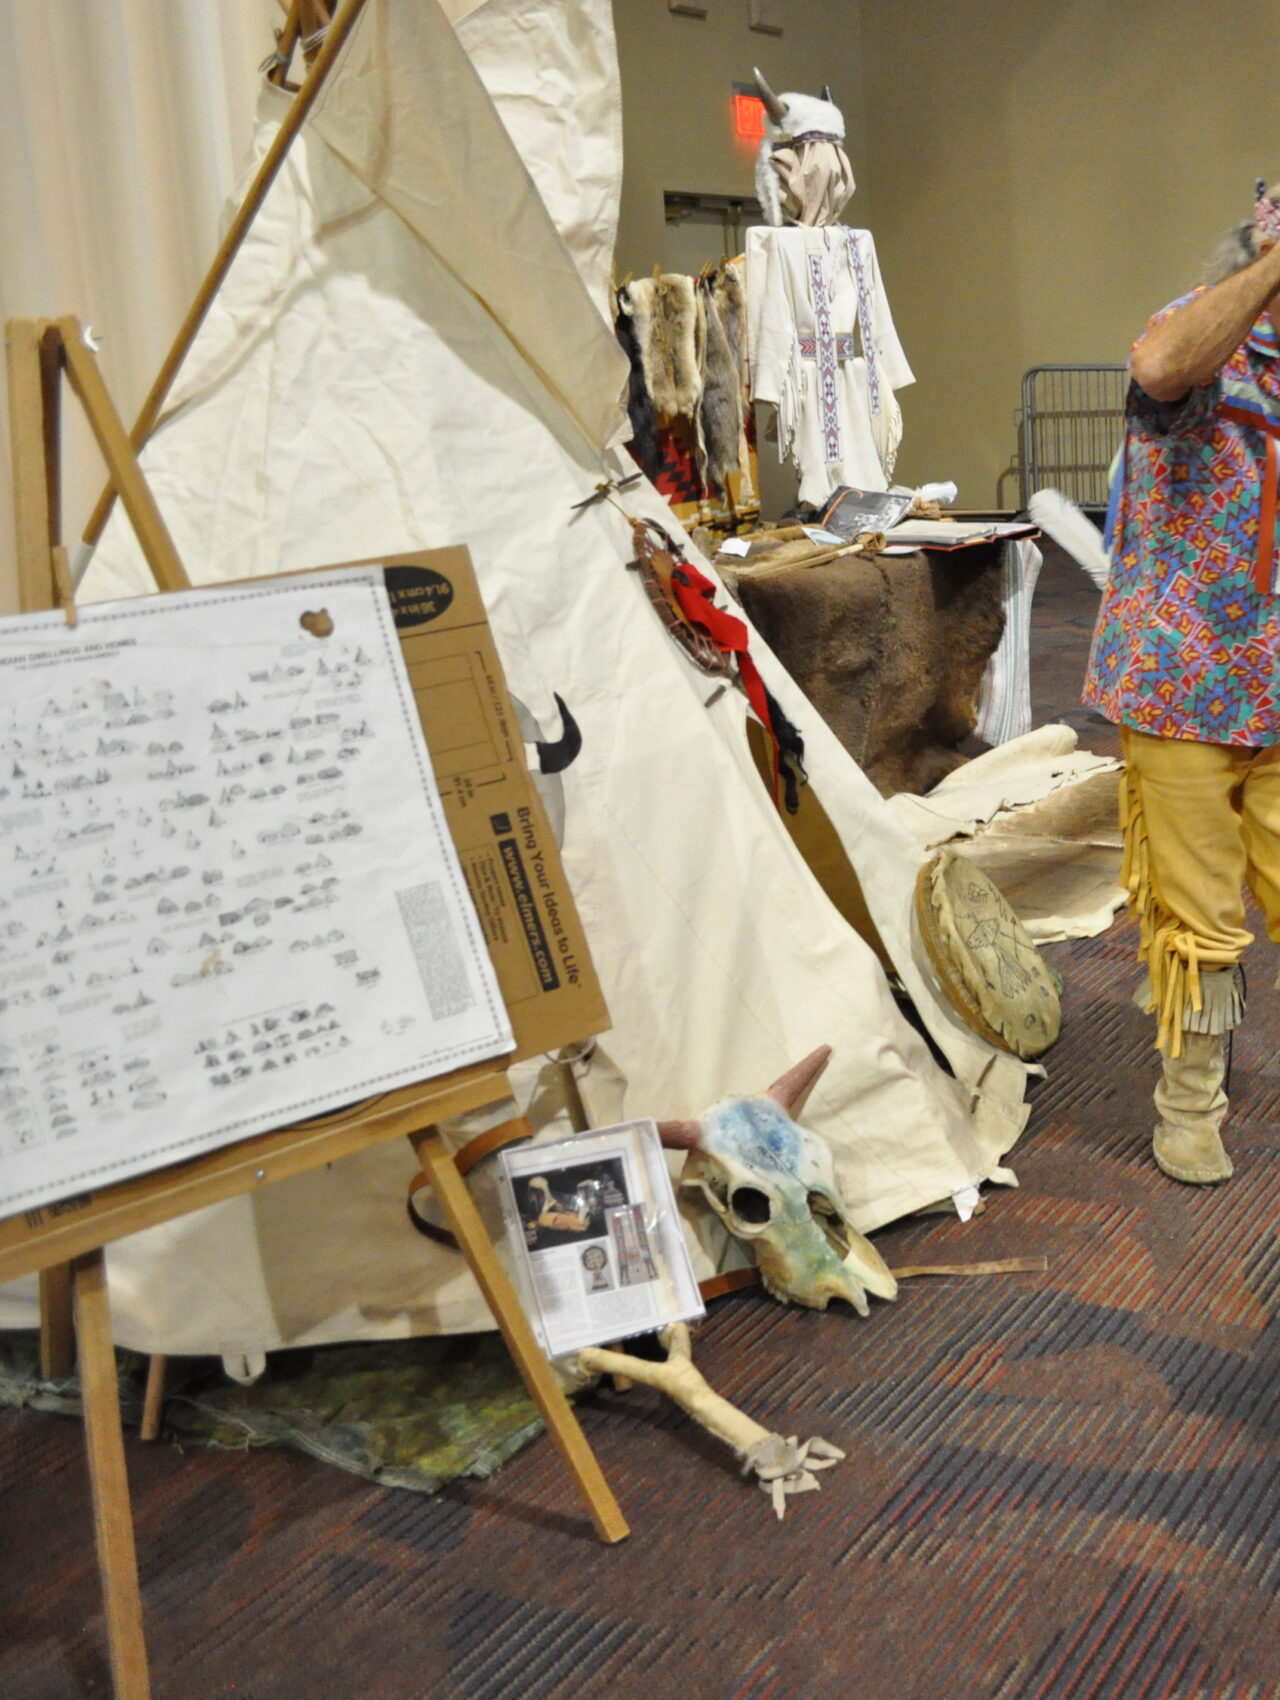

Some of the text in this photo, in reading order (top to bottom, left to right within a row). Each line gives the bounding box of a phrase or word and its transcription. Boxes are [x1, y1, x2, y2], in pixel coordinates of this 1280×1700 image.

[503, 846, 553, 983] www.elmers.com
[517, 806, 581, 985] Bring Your Ideas to Life
